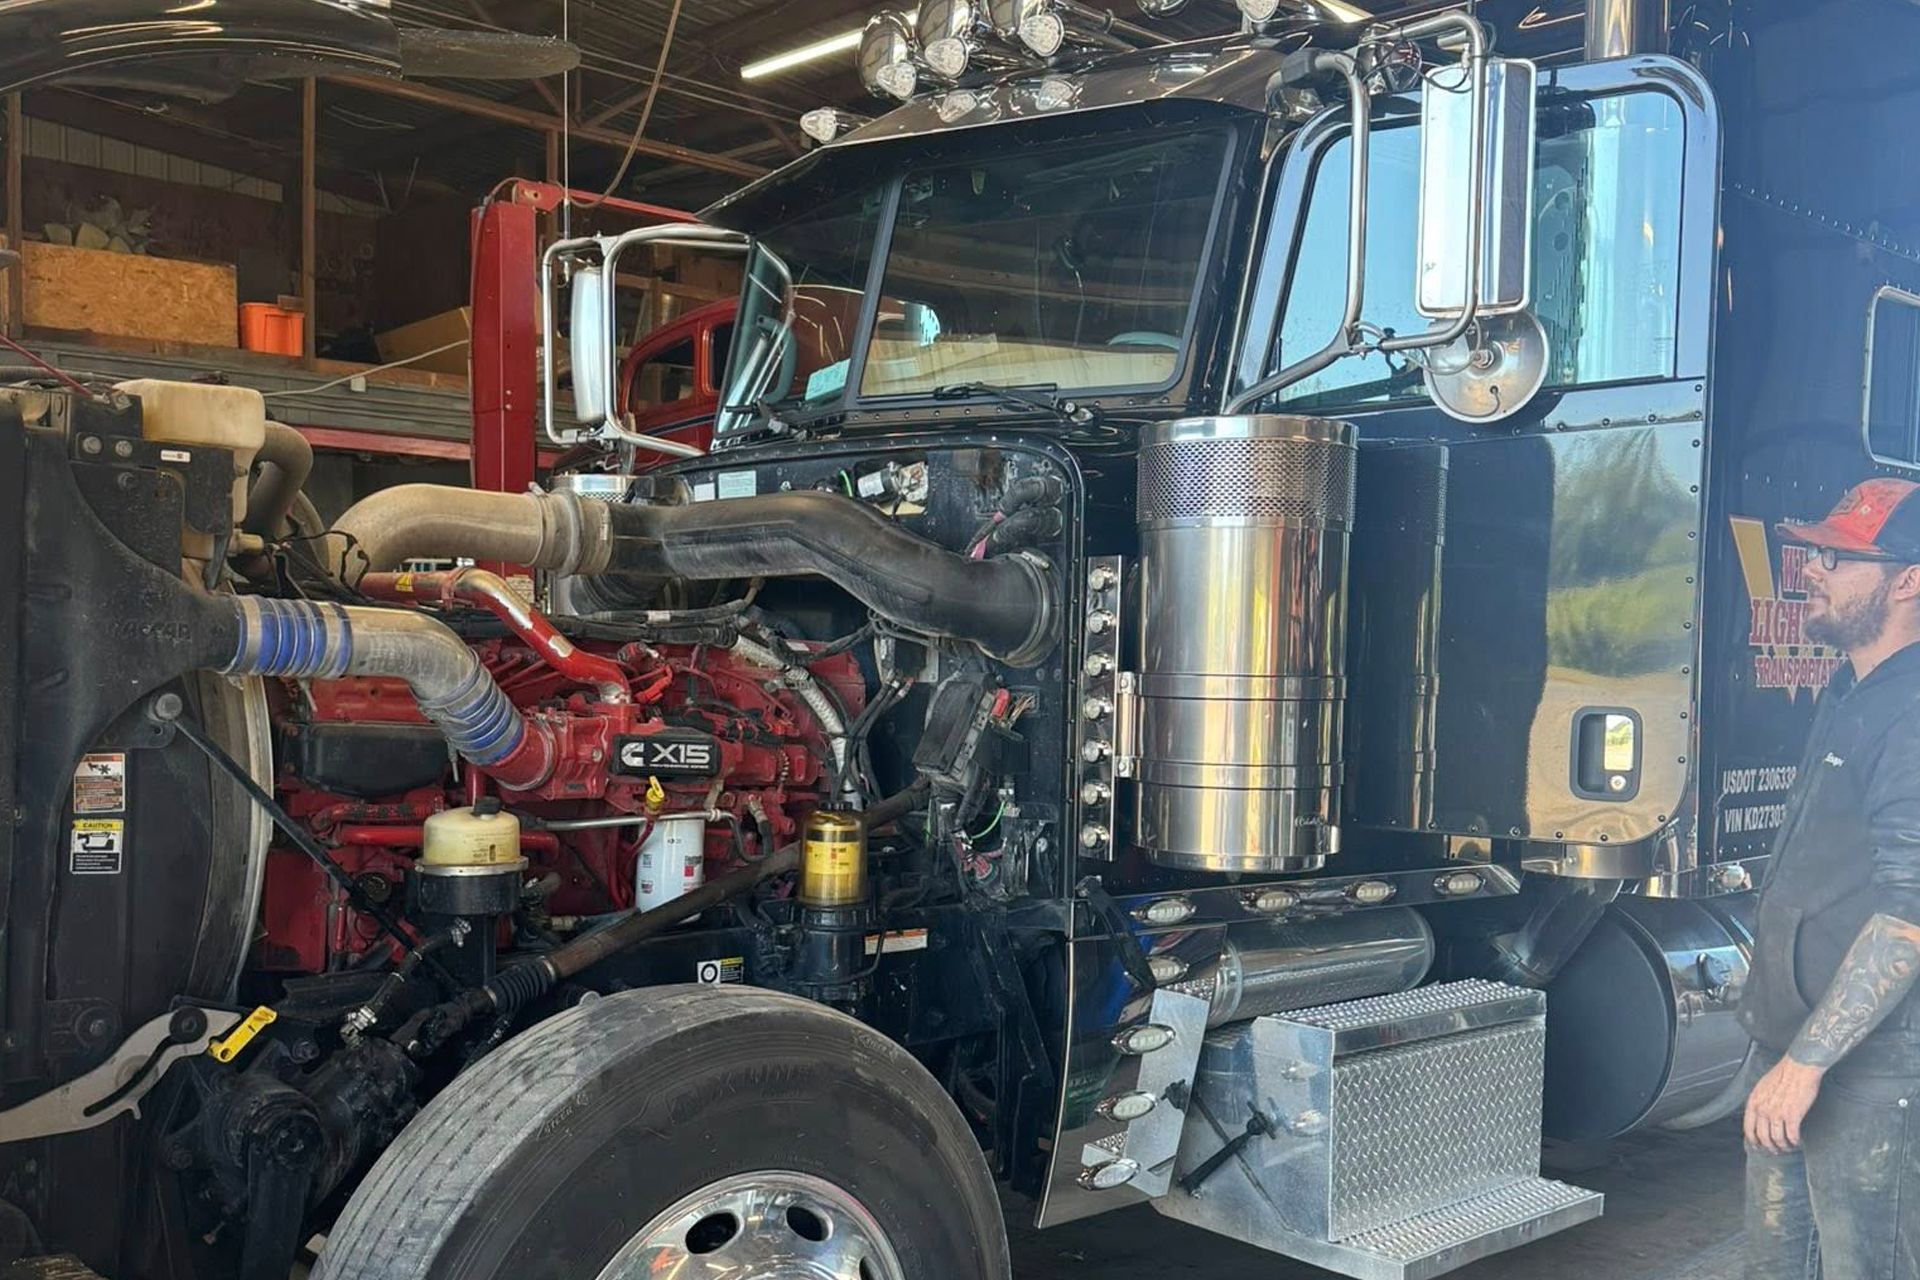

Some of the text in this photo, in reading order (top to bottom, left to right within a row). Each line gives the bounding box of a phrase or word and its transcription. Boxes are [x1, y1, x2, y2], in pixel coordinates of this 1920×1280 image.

[651, 743, 710, 764] X15
[1723, 769, 1757, 794] USDOT
[1725, 808, 1743, 833] VIN
